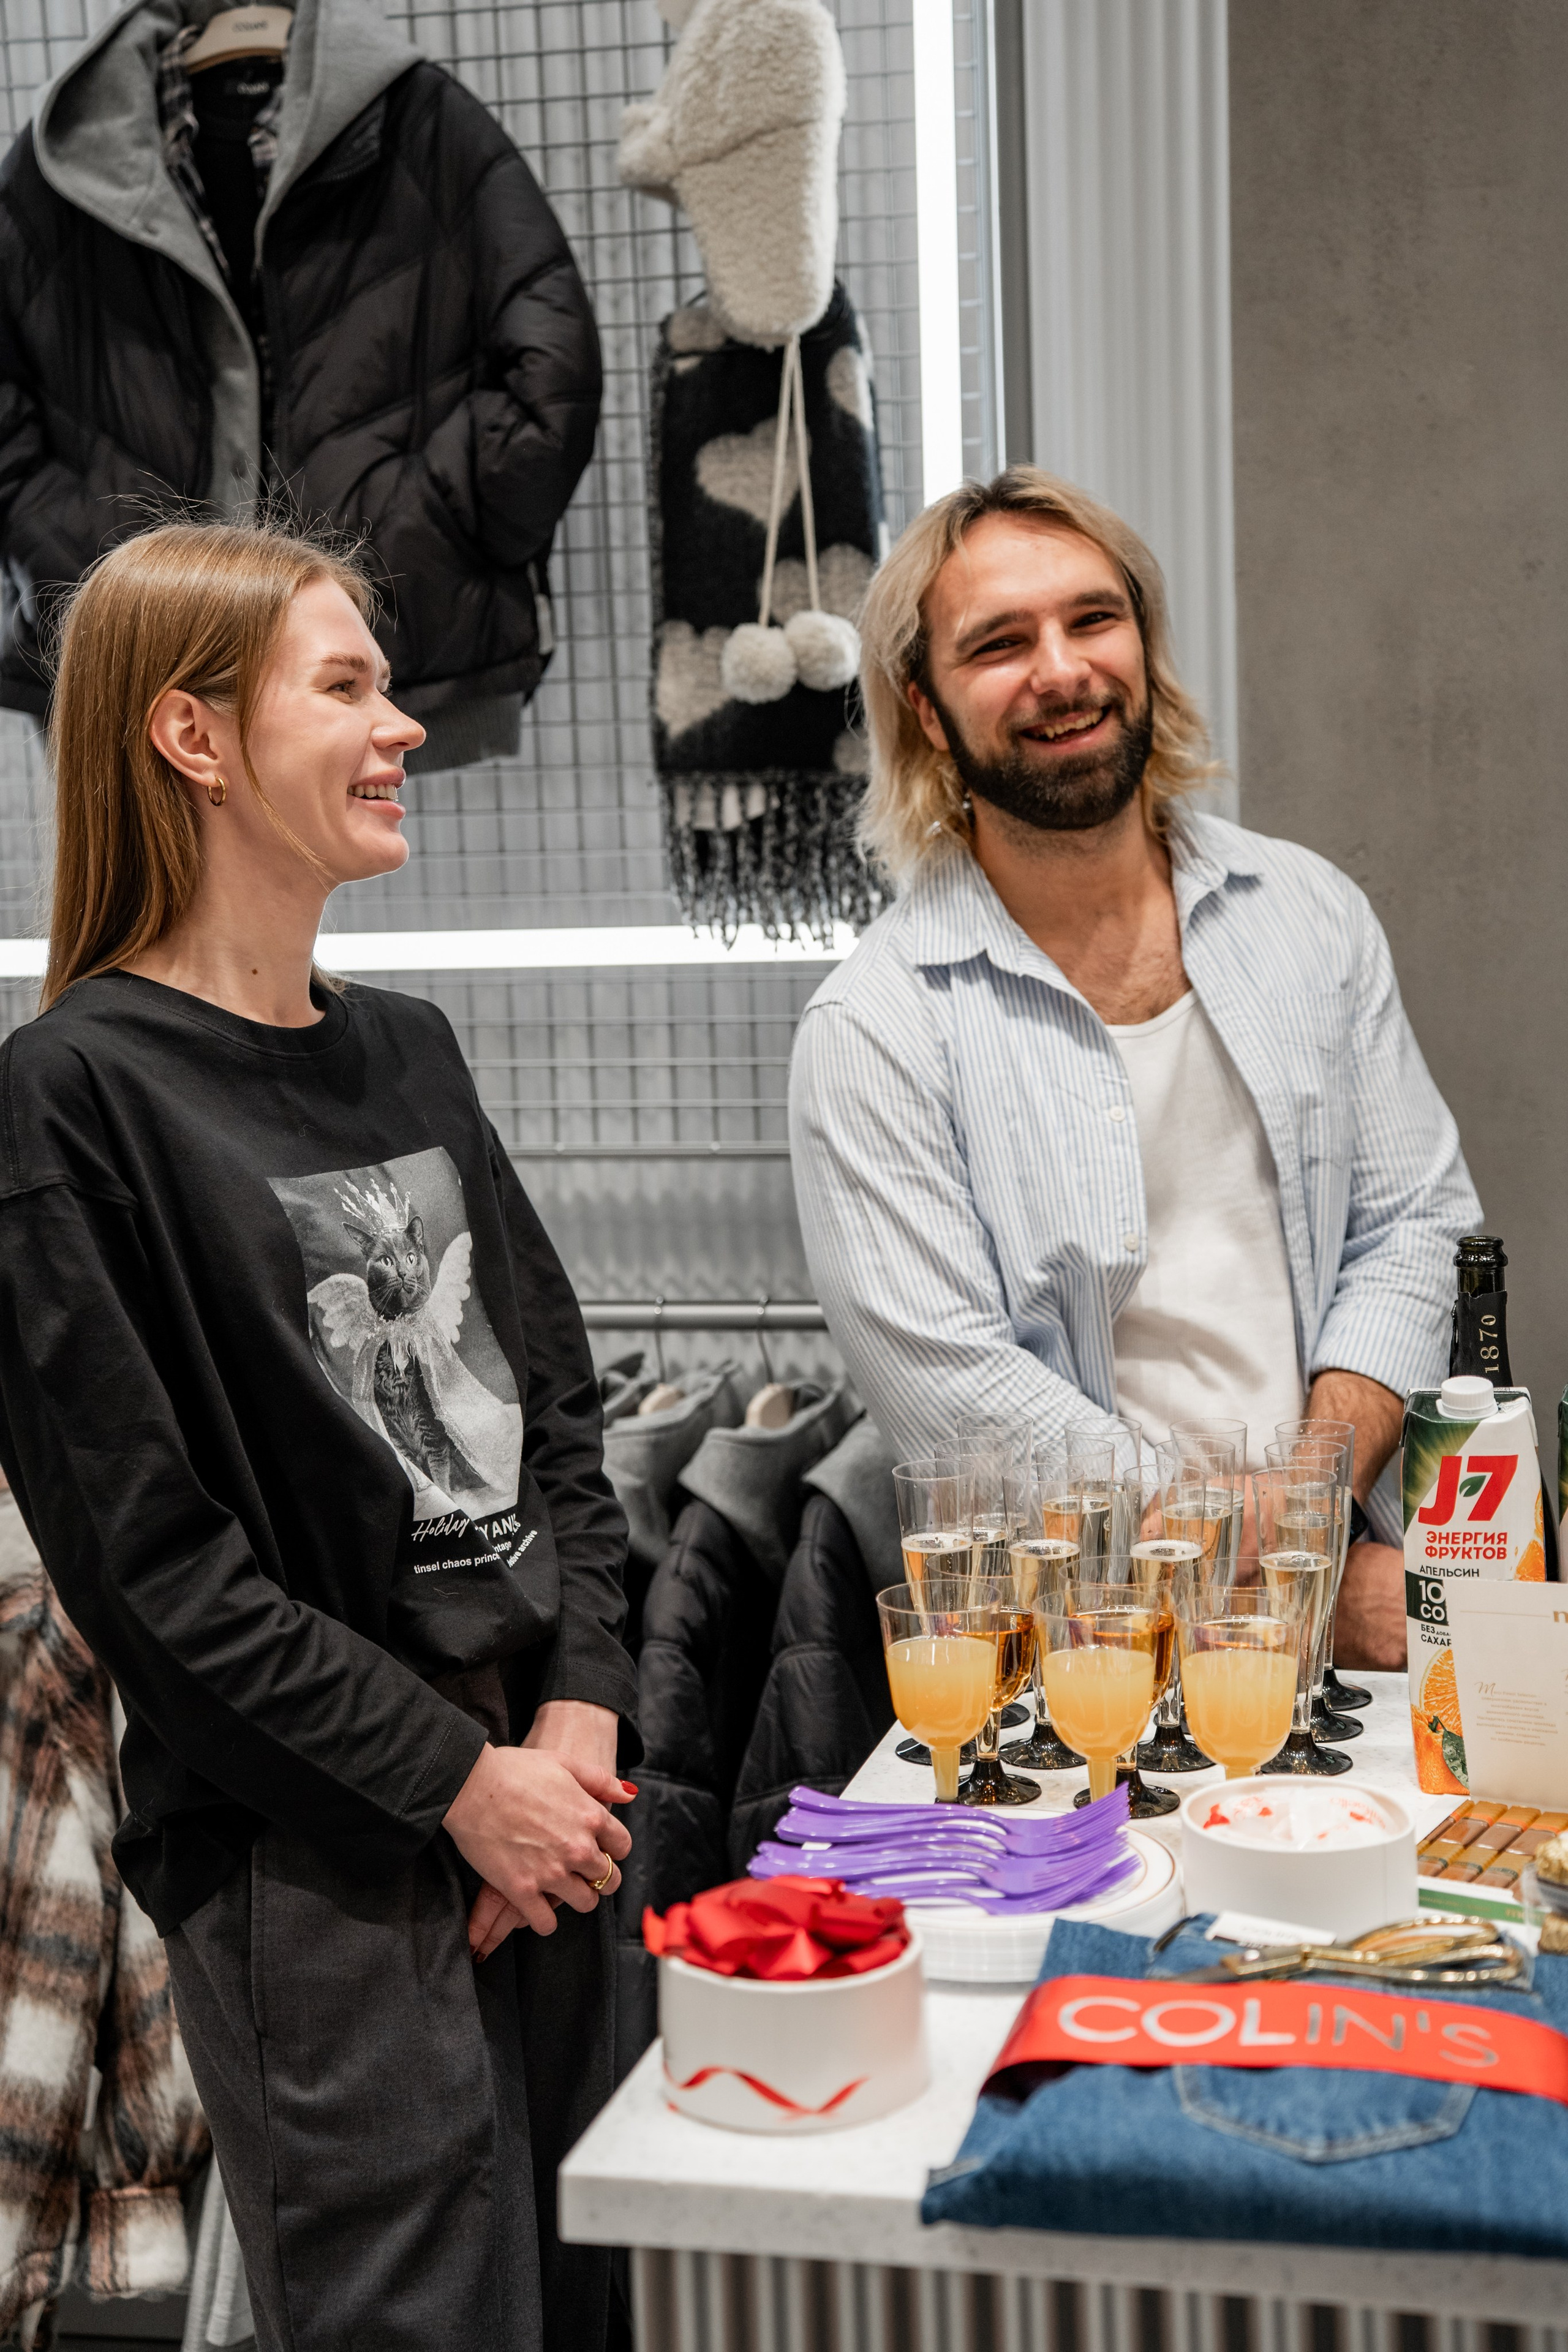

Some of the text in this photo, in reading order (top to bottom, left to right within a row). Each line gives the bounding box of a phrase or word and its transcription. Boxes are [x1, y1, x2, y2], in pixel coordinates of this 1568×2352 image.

[1479, 1313, 1500, 1373] 1870
[1417, 1455, 1519, 1526] J7
[411, 1513, 470, 1542] Holiday
[1426, 1531, 1508, 1546] ЭНЕРГИЯ
[413, 1561, 440, 1574] tinsel
[442, 1558, 472, 1569] chaos
[518, 1530, 538, 1553] archive
[492, 1540, 512, 1553] ntage
[1425, 1545, 1507, 1561] ФРУКТОВ
[1419, 1564, 1480, 1578] АПЕЛЬСИН
[1420, 1623, 1436, 1634] БЕЗ
[1057, 1996, 1500, 2068] COLIN'S
